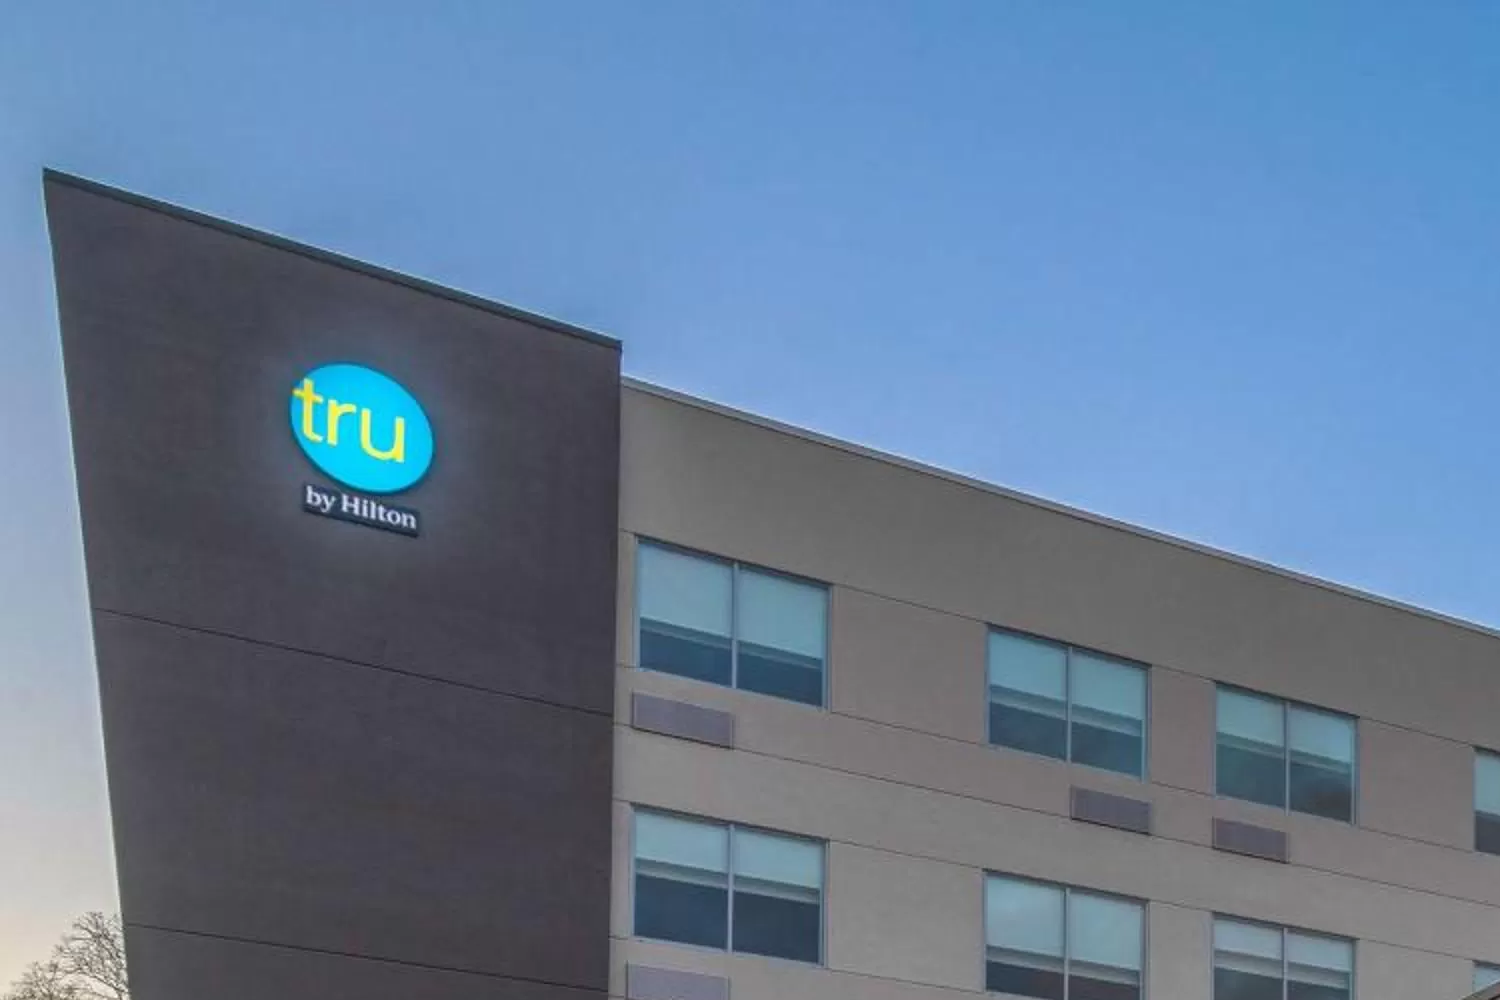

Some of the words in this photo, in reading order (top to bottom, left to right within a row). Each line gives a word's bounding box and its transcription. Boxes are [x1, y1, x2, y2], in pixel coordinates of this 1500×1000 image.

[292, 377, 405, 463] tru
[306, 485, 335, 513] by
[341, 493, 417, 529] Hilton
